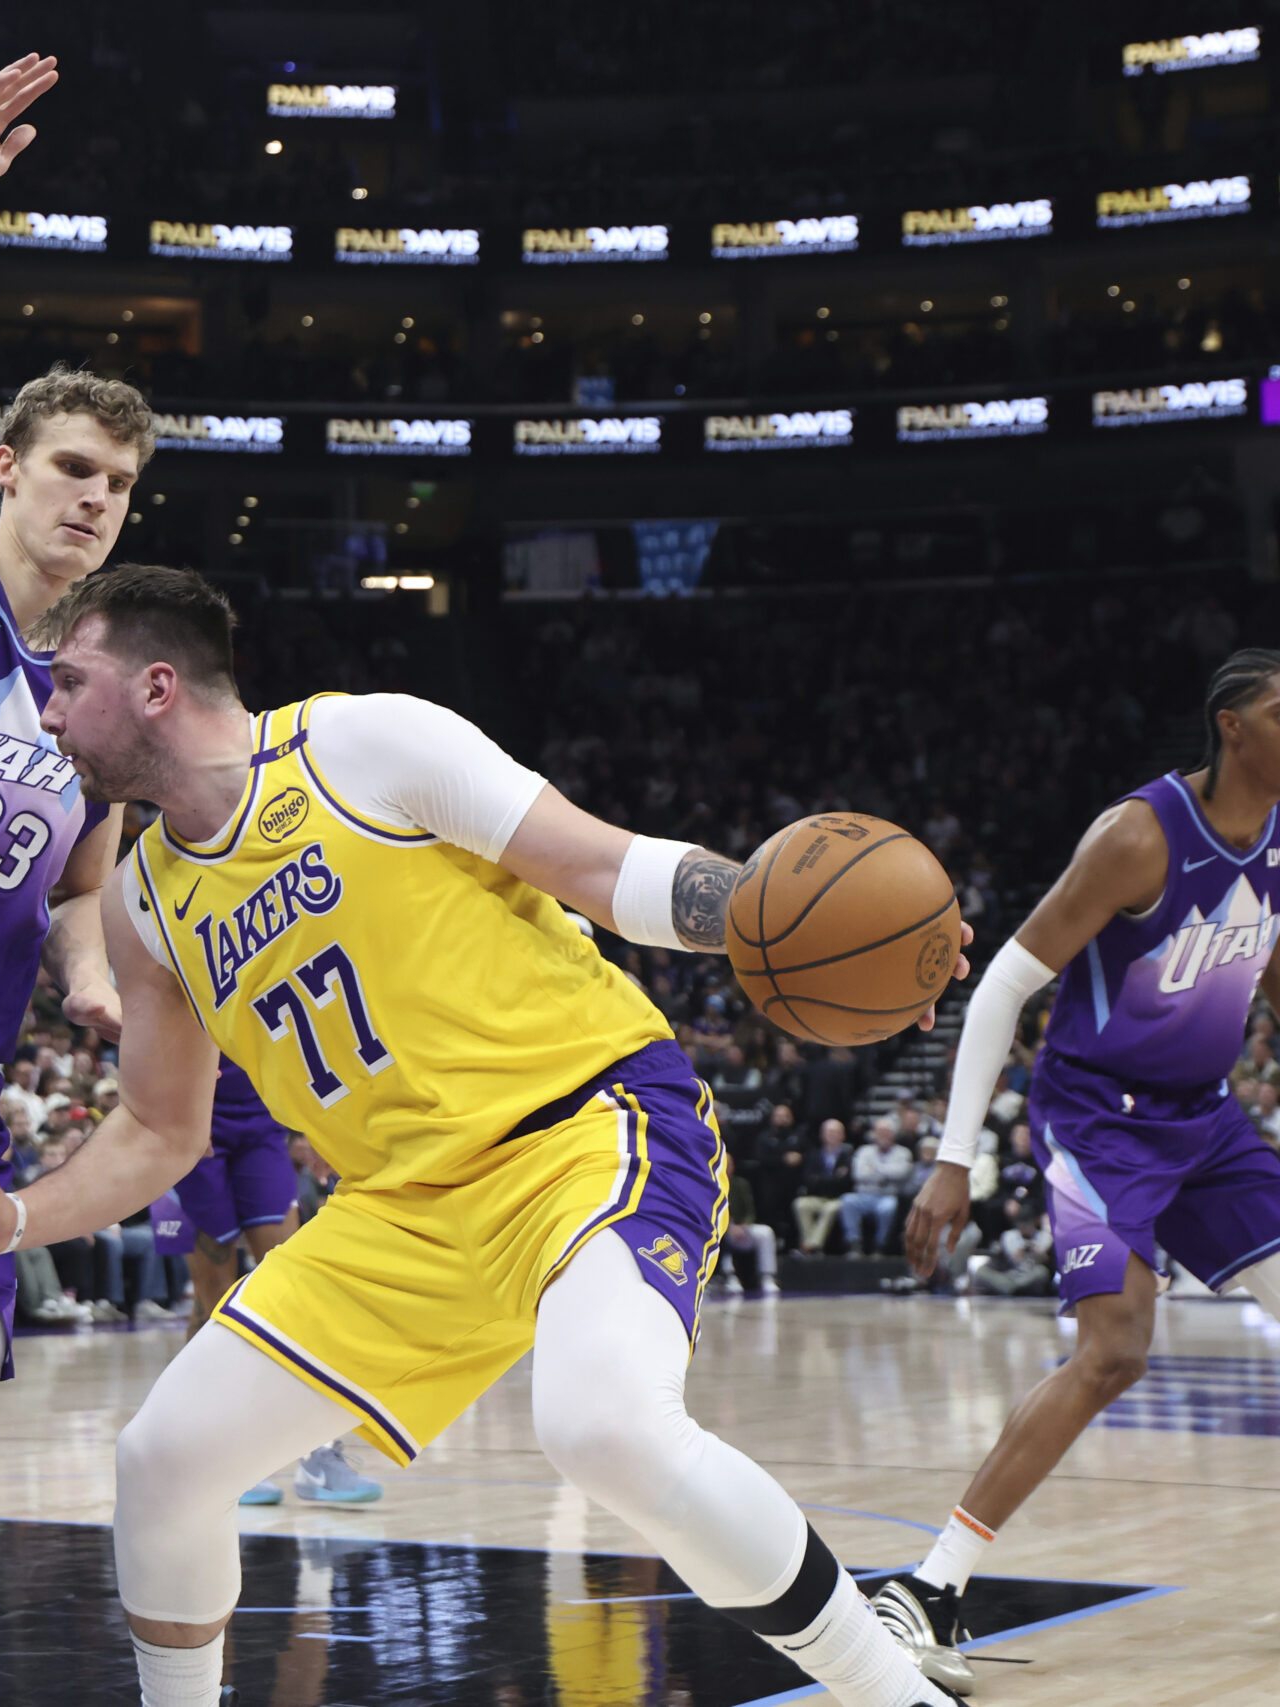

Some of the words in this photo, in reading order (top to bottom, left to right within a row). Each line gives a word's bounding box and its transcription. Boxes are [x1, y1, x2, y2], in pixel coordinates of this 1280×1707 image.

[276, 742, 290, 757] 44
[262, 795, 305, 833] bibigo
[193, 841, 343, 1013] LAKERS
[1158, 914, 1278, 994] UTAH
[248, 940, 396, 1109] 77
[1063, 1243, 1104, 1274] JAZZ
